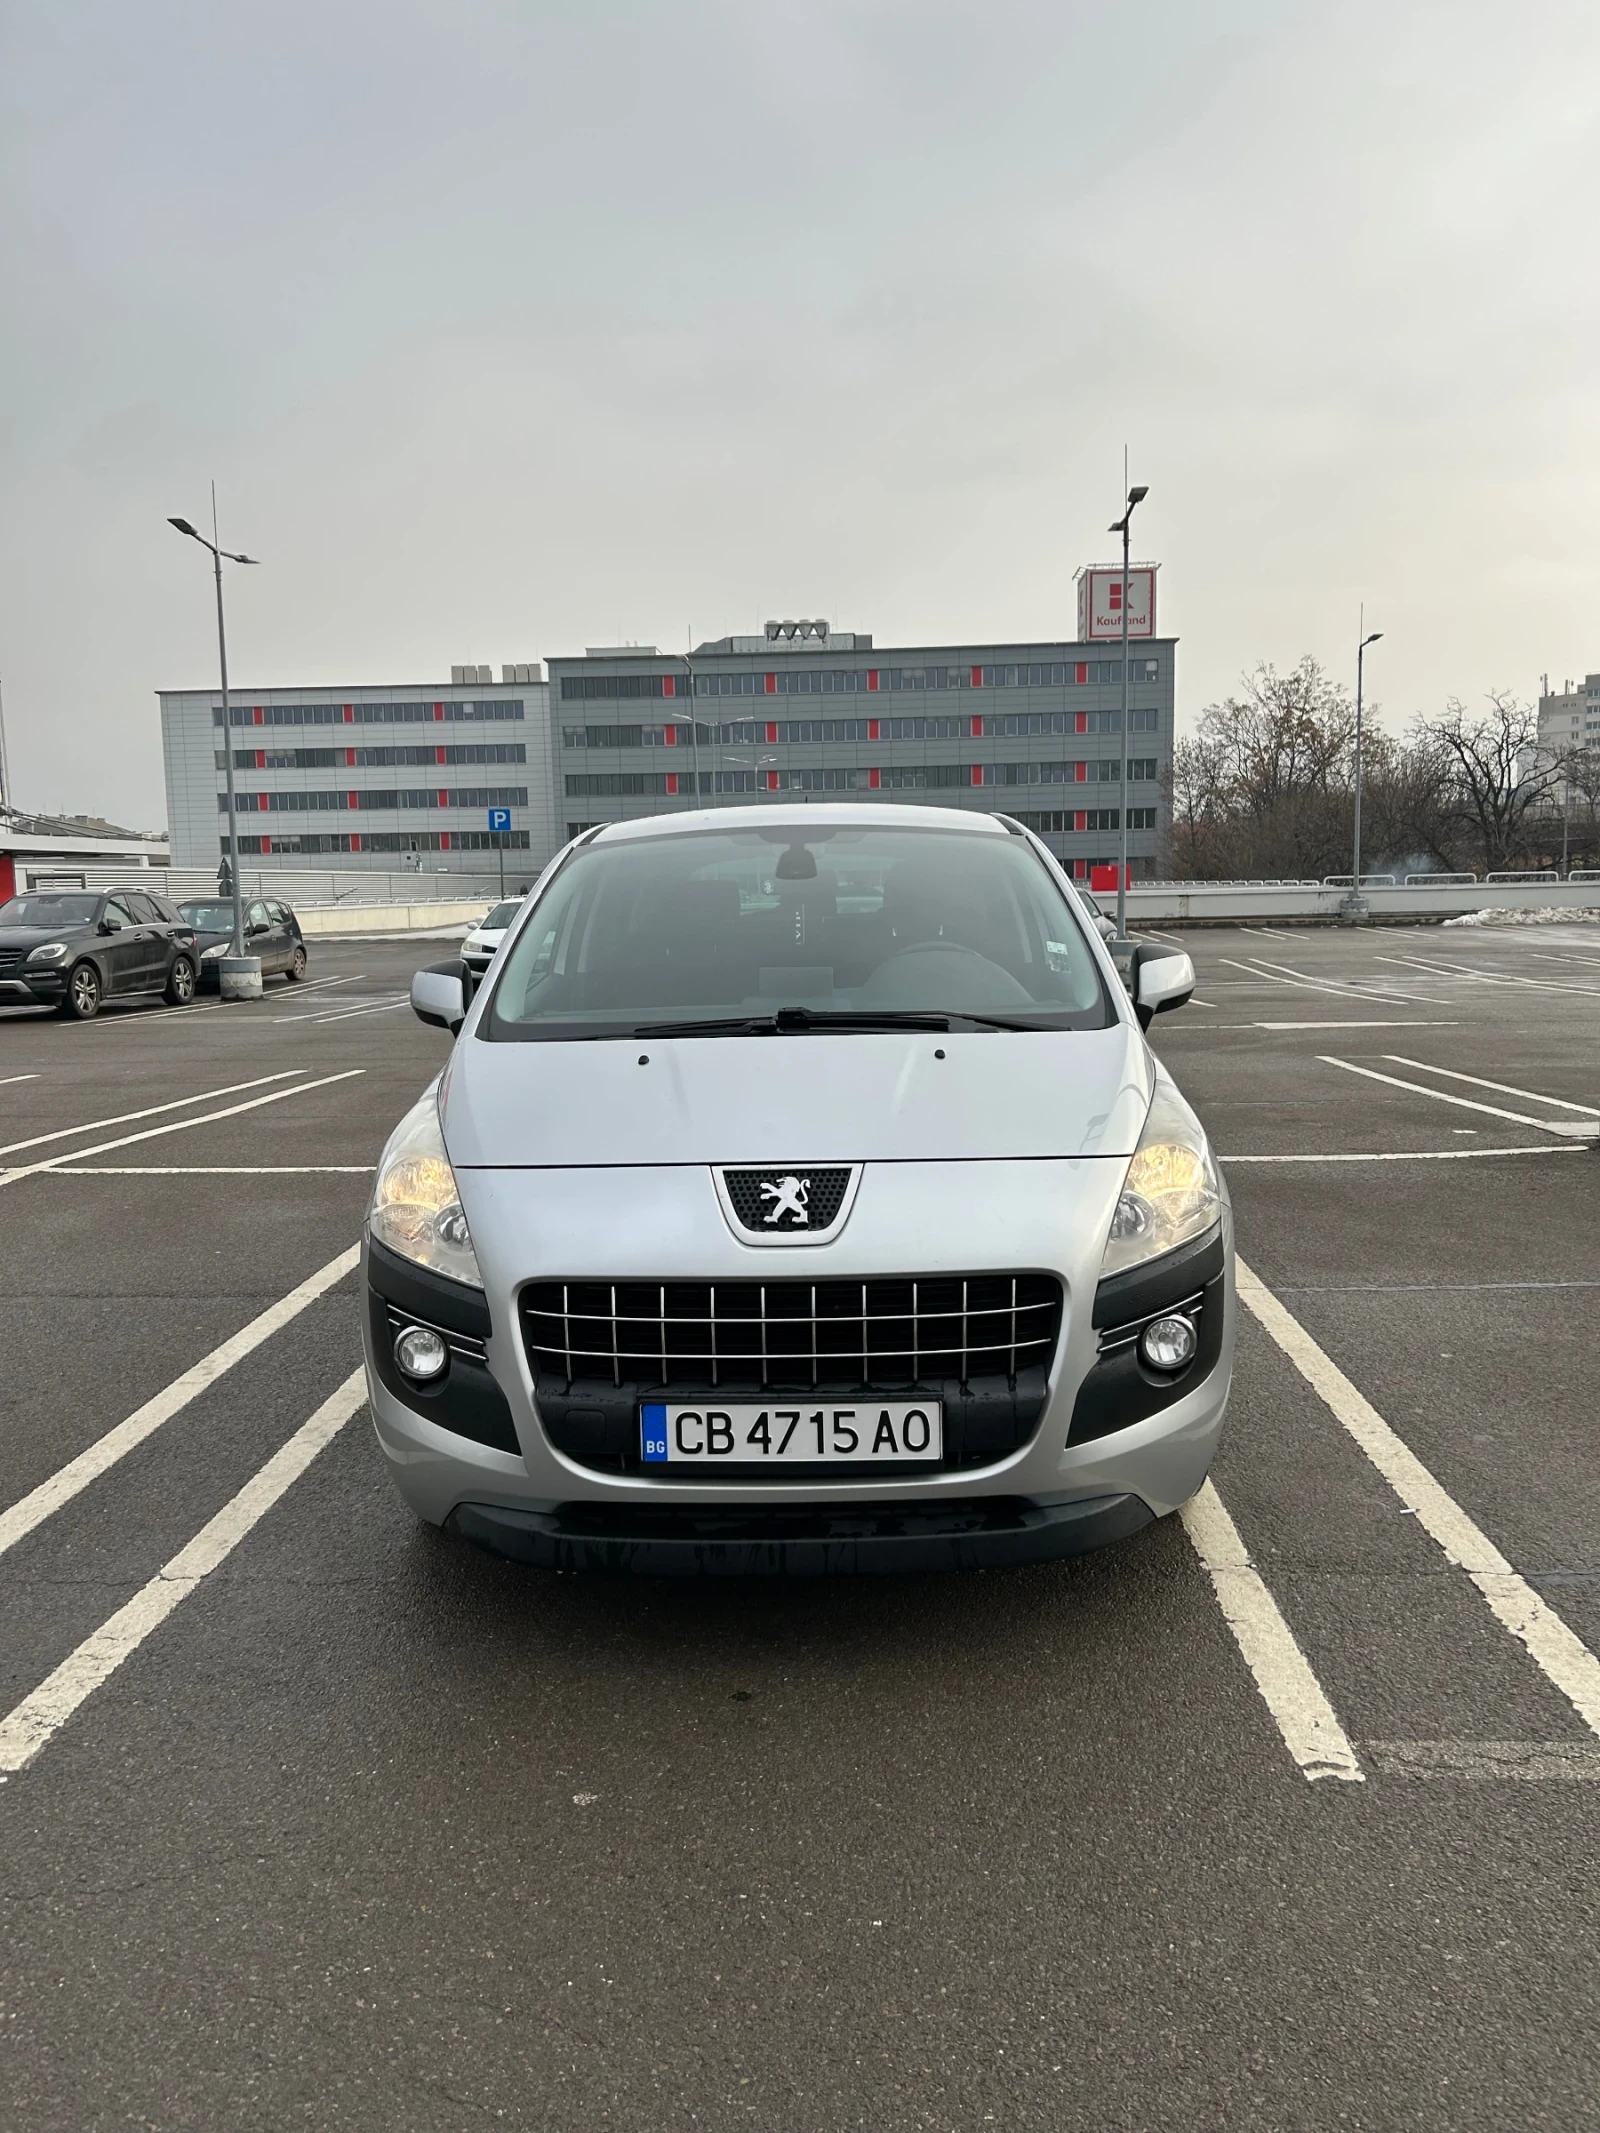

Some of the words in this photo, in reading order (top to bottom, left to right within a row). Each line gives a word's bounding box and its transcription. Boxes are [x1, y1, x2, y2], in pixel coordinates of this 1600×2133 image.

[1096, 614, 1146, 626] Kaufand
[494, 811, 506, 828] P
[675, 1411, 735, 1454] CB
[746, 1411, 859, 1454] 4715
[646, 1440, 665, 1454] BG
